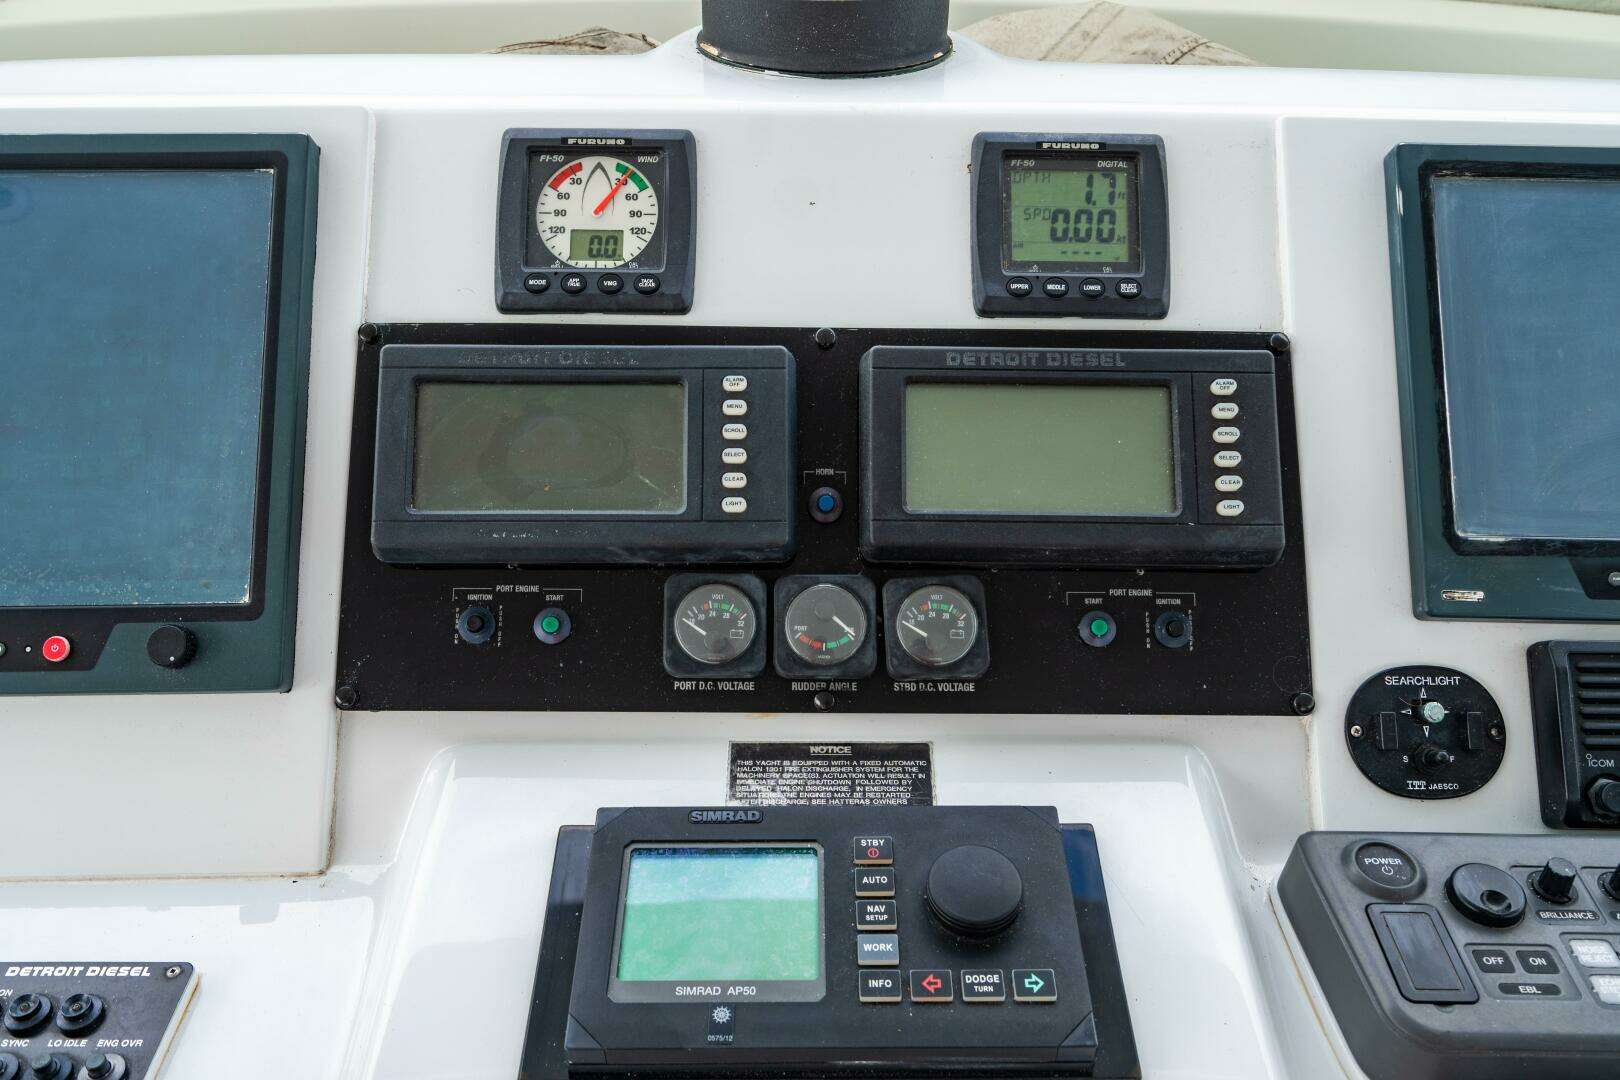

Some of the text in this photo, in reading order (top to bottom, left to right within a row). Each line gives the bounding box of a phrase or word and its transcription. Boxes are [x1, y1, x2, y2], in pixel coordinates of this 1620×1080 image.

[1097, 160, 1128, 168] DIGITAL
[569, 178, 582, 186] 30
[557, 192, 570, 200] 60
[625, 193, 639, 201] 60
[553, 209, 567, 217] 90
[629, 210, 643, 218] 90
[548, 226, 566, 234] 120
[1050, 208, 1117, 243] 0.00
[629, 227, 647, 235] 120
[946, 352, 1127, 367] DETROIT DIESEL
[496, 585, 540, 593] PORT ENGINE
[1128, 589, 1153, 597] ENGINE
[1385, 676, 1461, 686] SEARCHLIGHT
[674, 681, 697, 691] PORT
[717, 681, 755, 691] VOLTAGE
[791, 681, 858, 691] RUDDER ANGLE
[893, 682, 917, 692] STBD
[938, 682, 976, 692] VOLTAGE
[809, 745, 852, 754] NOTICE
[1407, 780, 1427, 790] ITT
[690, 810, 761, 823] SIMRAD
[860, 839, 885, 847] STBY
[862, 876, 888, 884] AUTO
[1539, 911, 1595, 920] BRILLIANCE
[863, 943, 893, 951] WORK
[1482, 957, 1504, 966] OFF
[1529, 957, 1547, 966] ON
[5, 966, 151, 977] DETROIT DIESEL
[965, 975, 1000, 983] DODGE
[868, 980, 892, 988] INFO
[675, 986, 757, 996] SIMRAD AP50
[1518, 986, 1541, 994] EBL
[1, 1039, 30, 1048] SYNC
[47, 1039, 88, 1048] LO IDLE
[97, 1039, 144, 1048] ENG OVR
